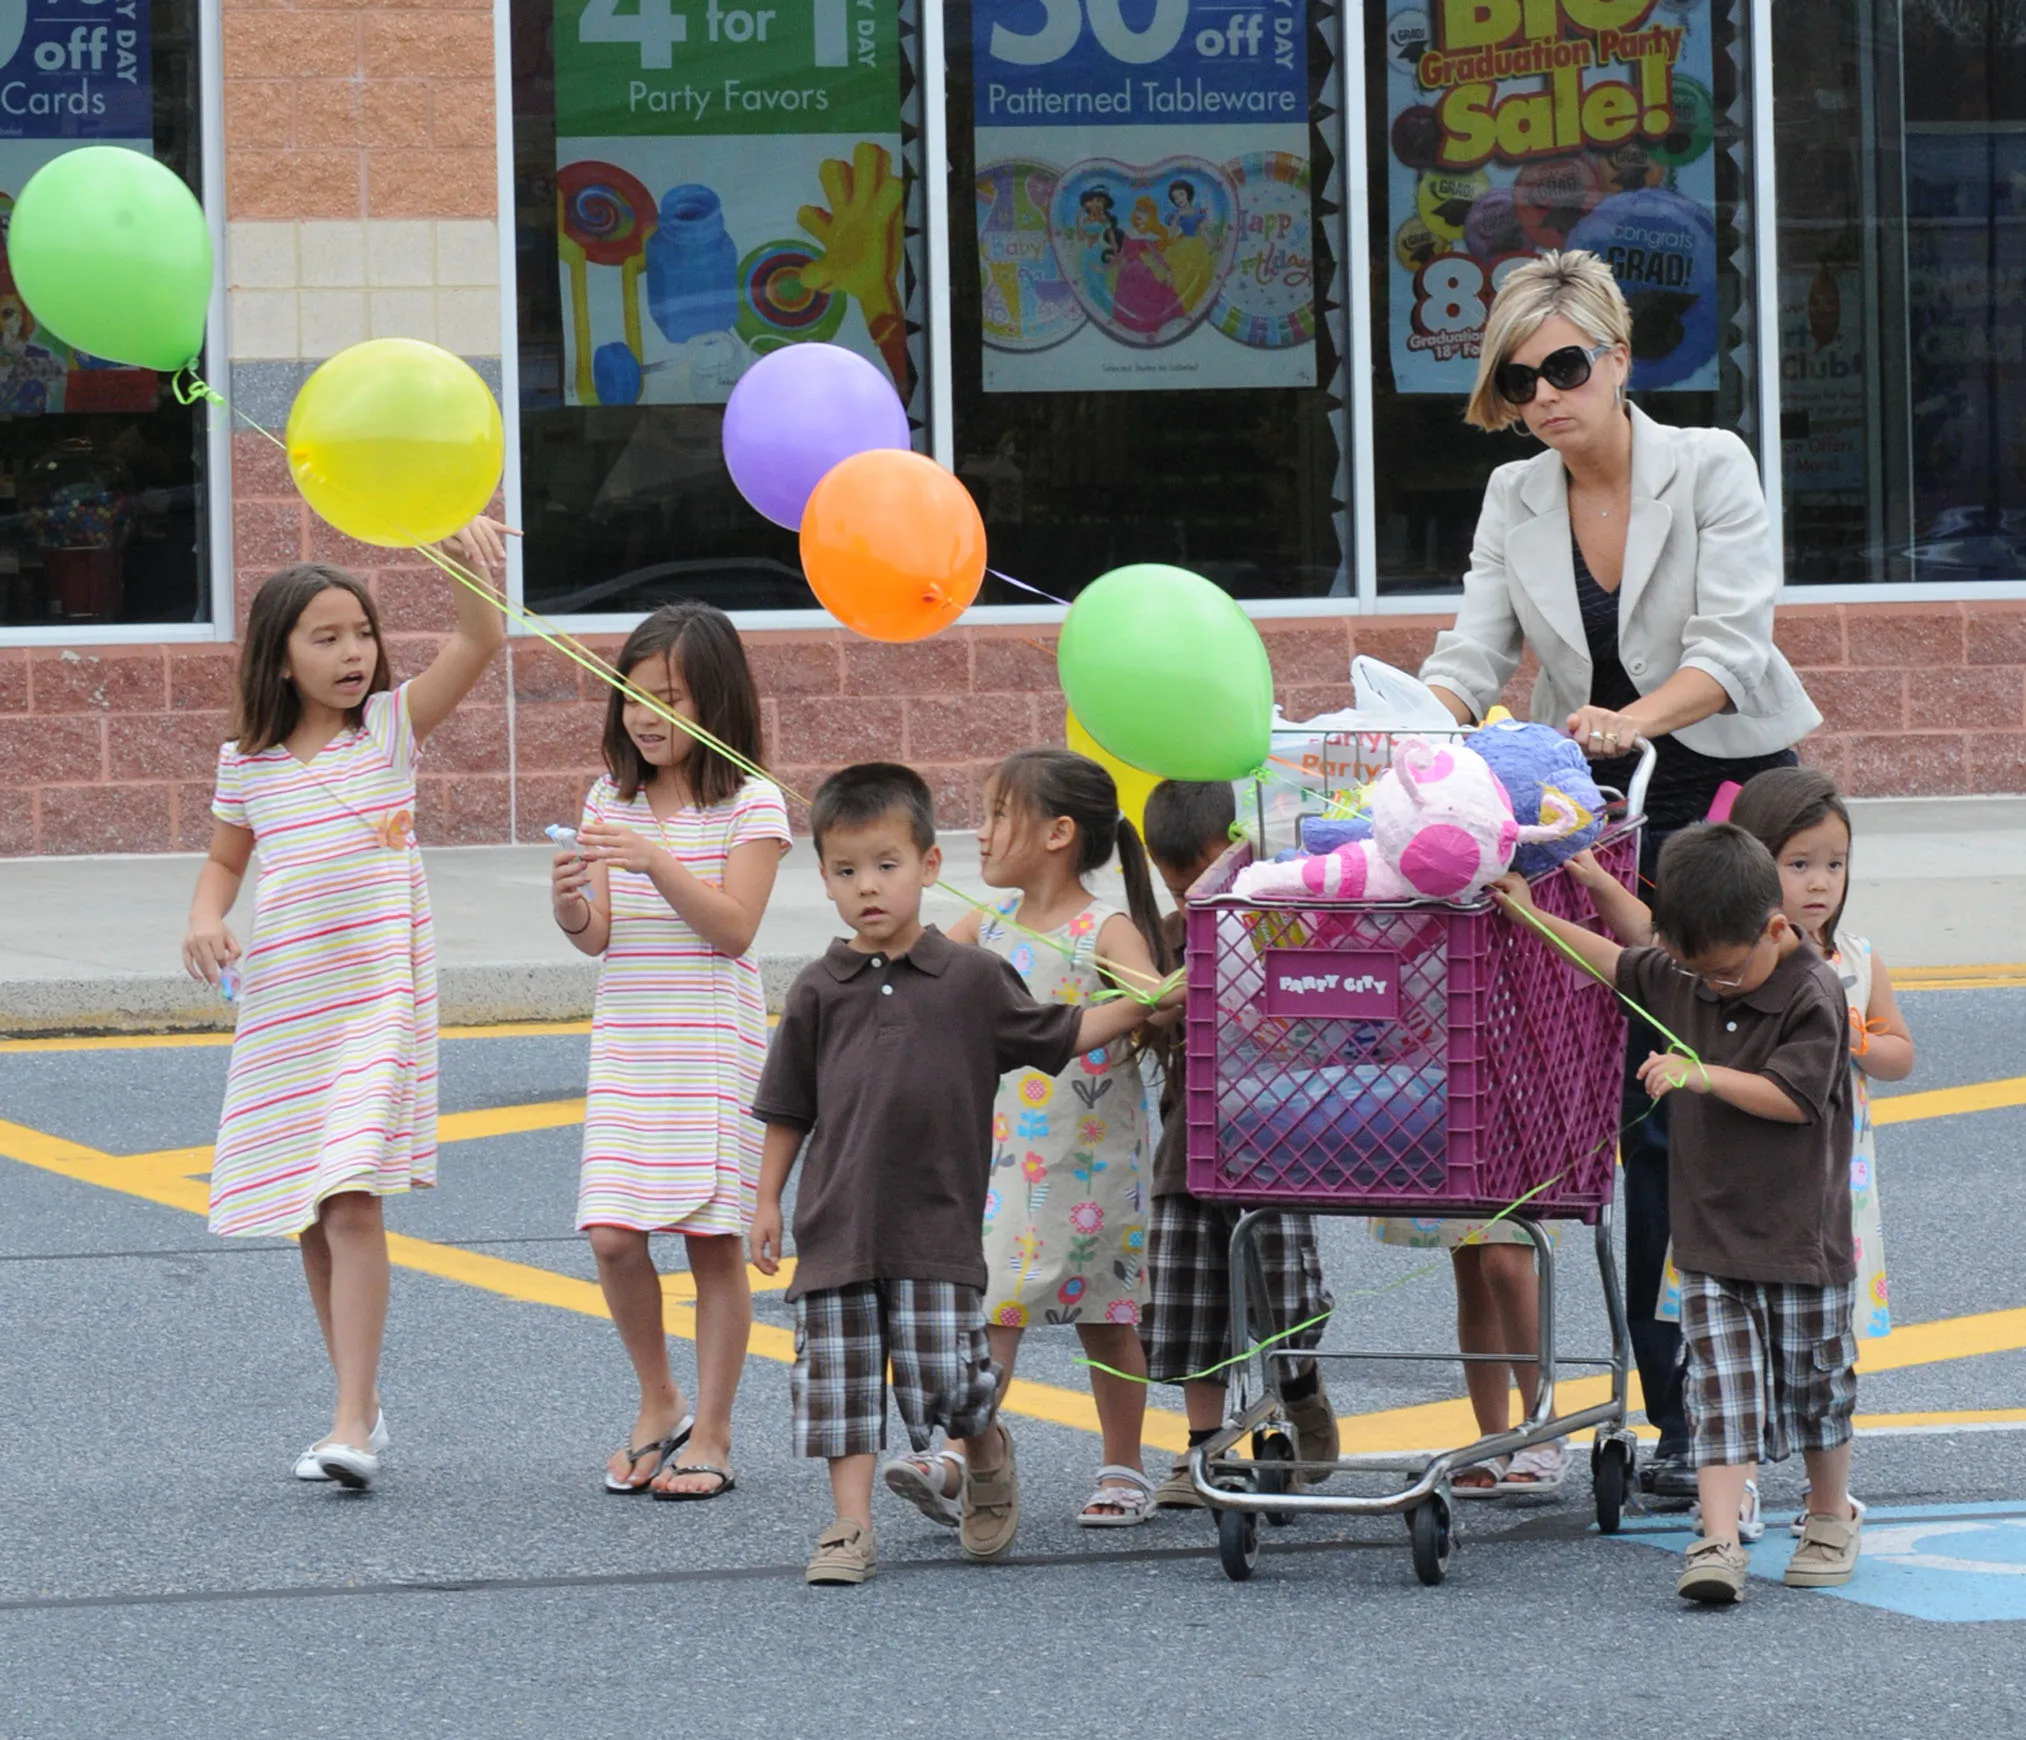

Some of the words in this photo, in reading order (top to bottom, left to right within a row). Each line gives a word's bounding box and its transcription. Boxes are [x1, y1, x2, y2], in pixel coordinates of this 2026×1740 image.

[34, 26, 108, 71] off
[579, 0, 687, 69] 4
[706, 0, 776, 43] for
[856, 20, 876, 68] DAY
[1196, 14, 1264, 57] off
[1274, 18, 1294, 70] DAY
[1422, 37, 1591, 85] Graduation
[1601, 26, 1684, 63] Party
[116, 30, 138, 85] DAY
[1, 76, 106, 115] Cards
[628, 80, 712, 121] Party
[725, 80, 829, 112] Favors
[988, 78, 1131, 114] Patterned
[1142, 78, 1296, 113] Tableware
[1441, 56, 1670, 163] Sale!
[1611, 226, 1695, 249] congrats
[1606, 246, 1695, 288] GRAD!
[1302, 754, 1383, 785] Party
[1279, 974, 1340, 995] PARTY
[1343, 975, 1388, 995] CITY
